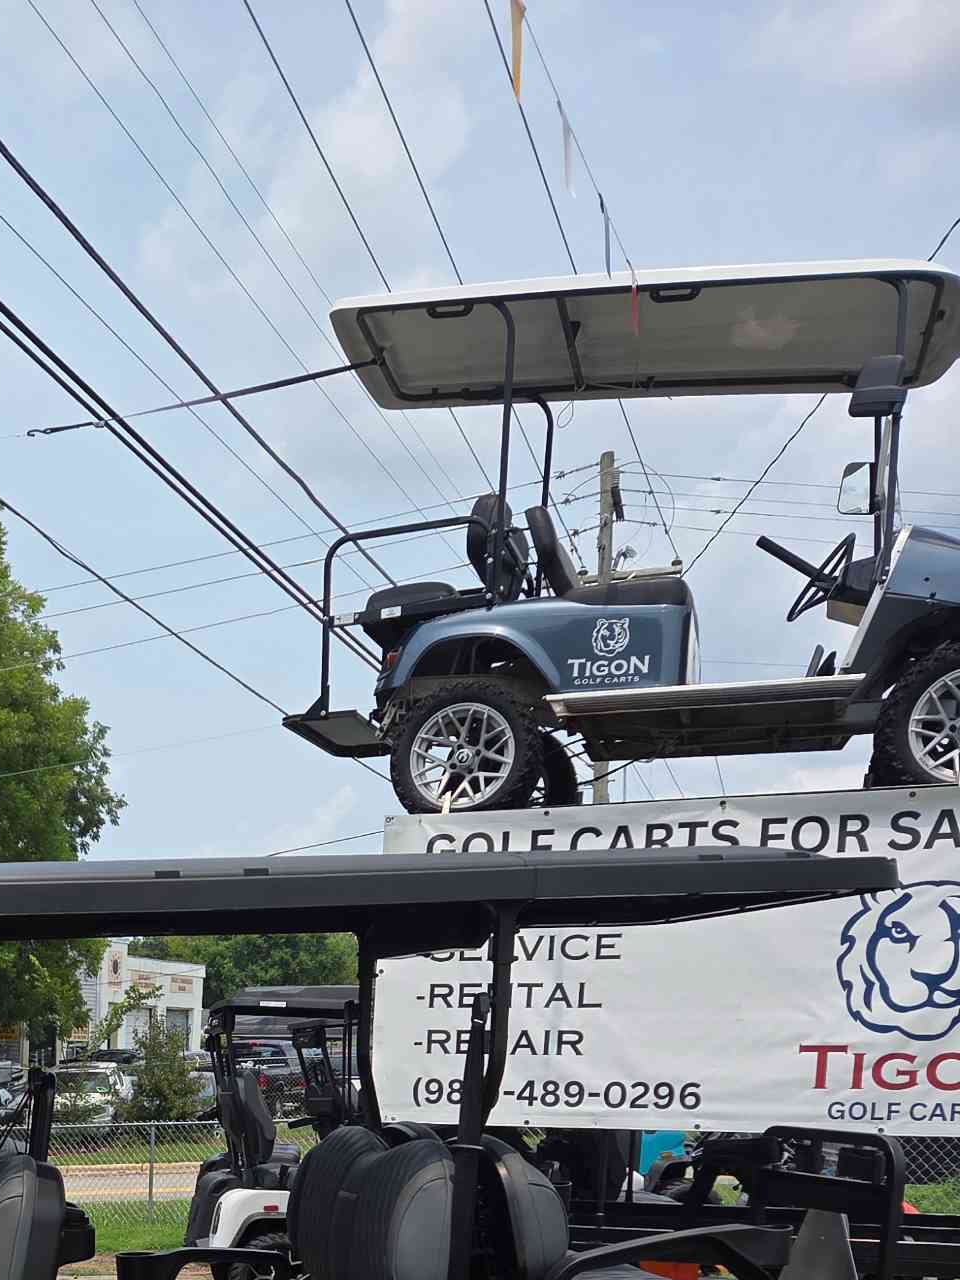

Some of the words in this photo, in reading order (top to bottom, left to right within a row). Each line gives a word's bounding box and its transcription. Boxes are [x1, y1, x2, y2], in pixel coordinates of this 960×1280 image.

[567, 655, 650, 677] TIGON
[573, 677, 602, 685] GOLF
[604, 675, 640, 684] CARTS
[569, 819, 741, 851] CARTS
[759, 813, 870, 853] FOR
[416, 982, 603, 1009] -RETAL
[413, 1028, 584, 1056] -REAIR
[412, 1077, 702, 1110] (98-489-0296
[827, 1101, 901, 1121] GOLF
